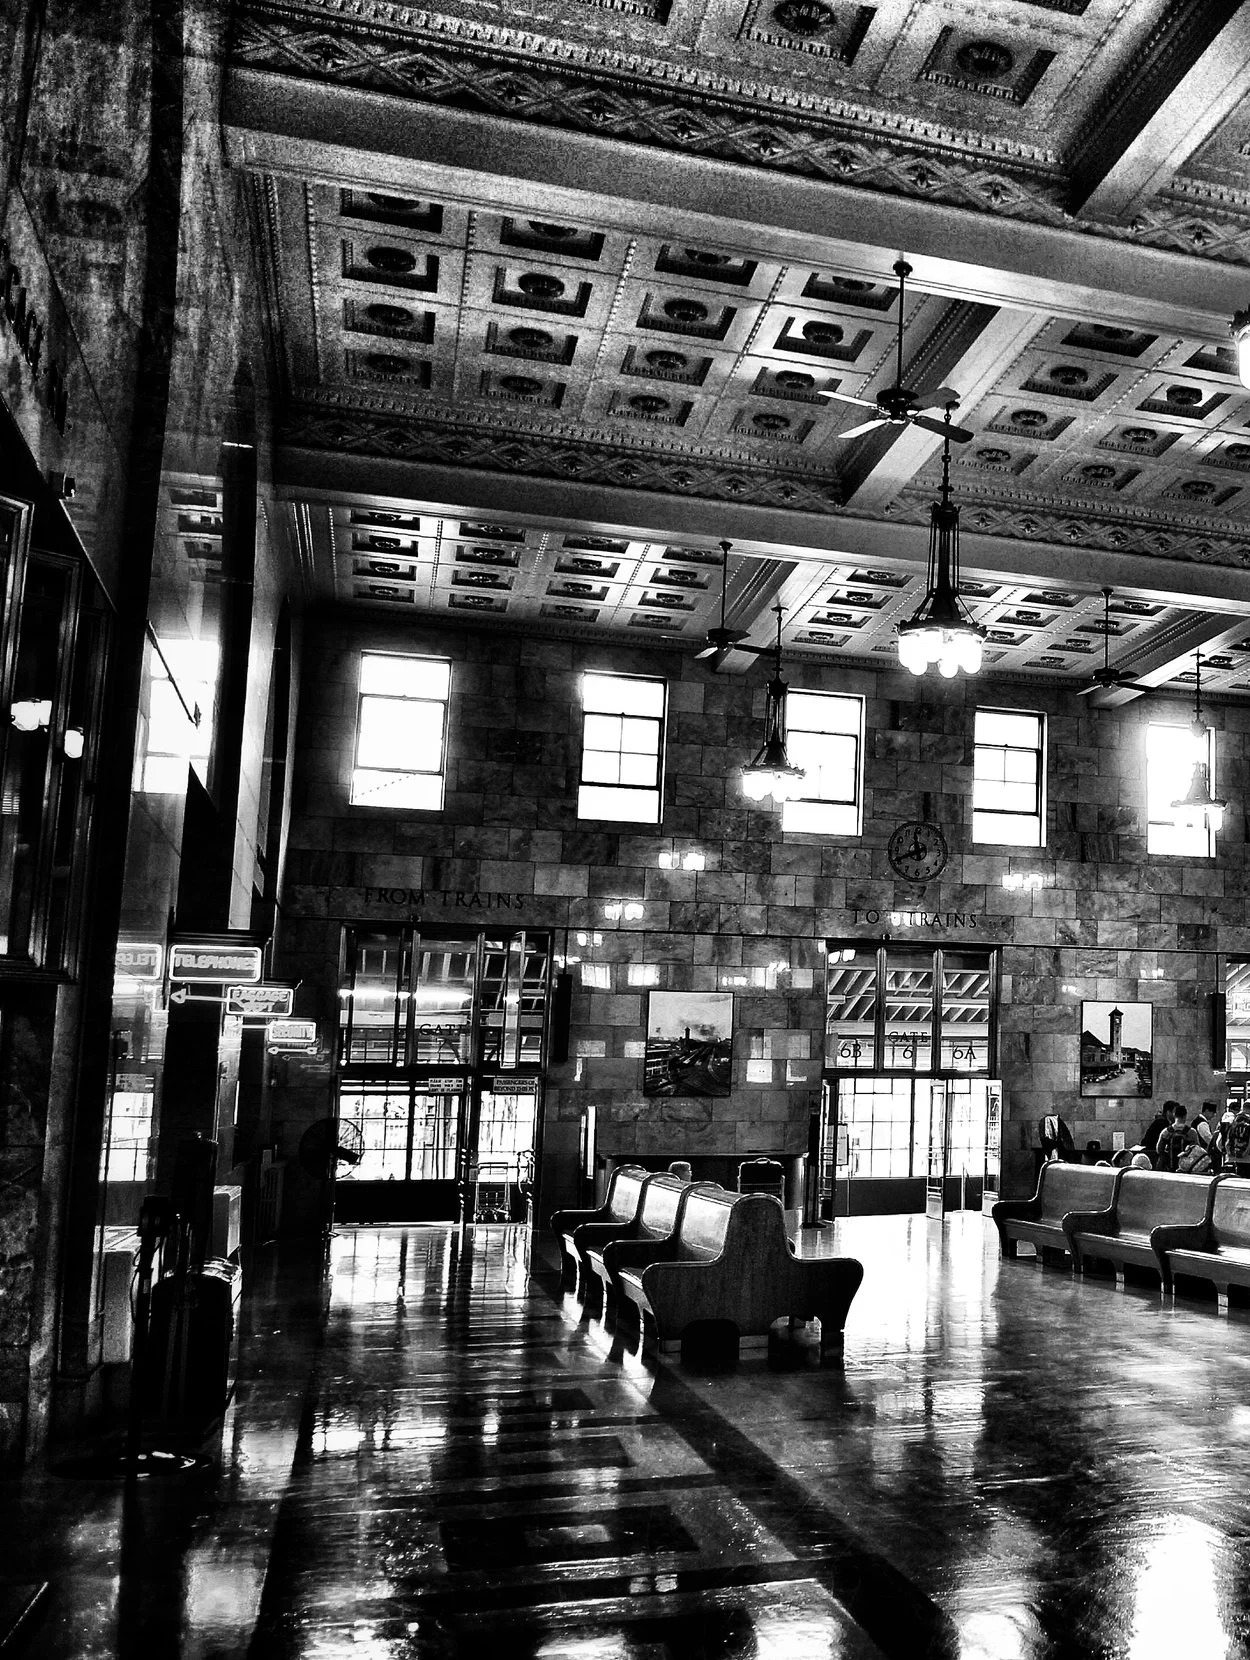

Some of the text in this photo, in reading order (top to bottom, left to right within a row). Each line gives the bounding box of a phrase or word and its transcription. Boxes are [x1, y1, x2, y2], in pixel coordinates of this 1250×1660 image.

[364, 888, 525, 910] FROM TRAINS
[852, 909, 977, 928] TO TRAINS
[174, 953, 257, 970] TELEPHONES
[888, 1031, 928, 1043] GATE
[840, 1043, 862, 1058] 6B
[902, 1045, 914, 1059] 6
[952, 1046, 977, 1060] 6A
